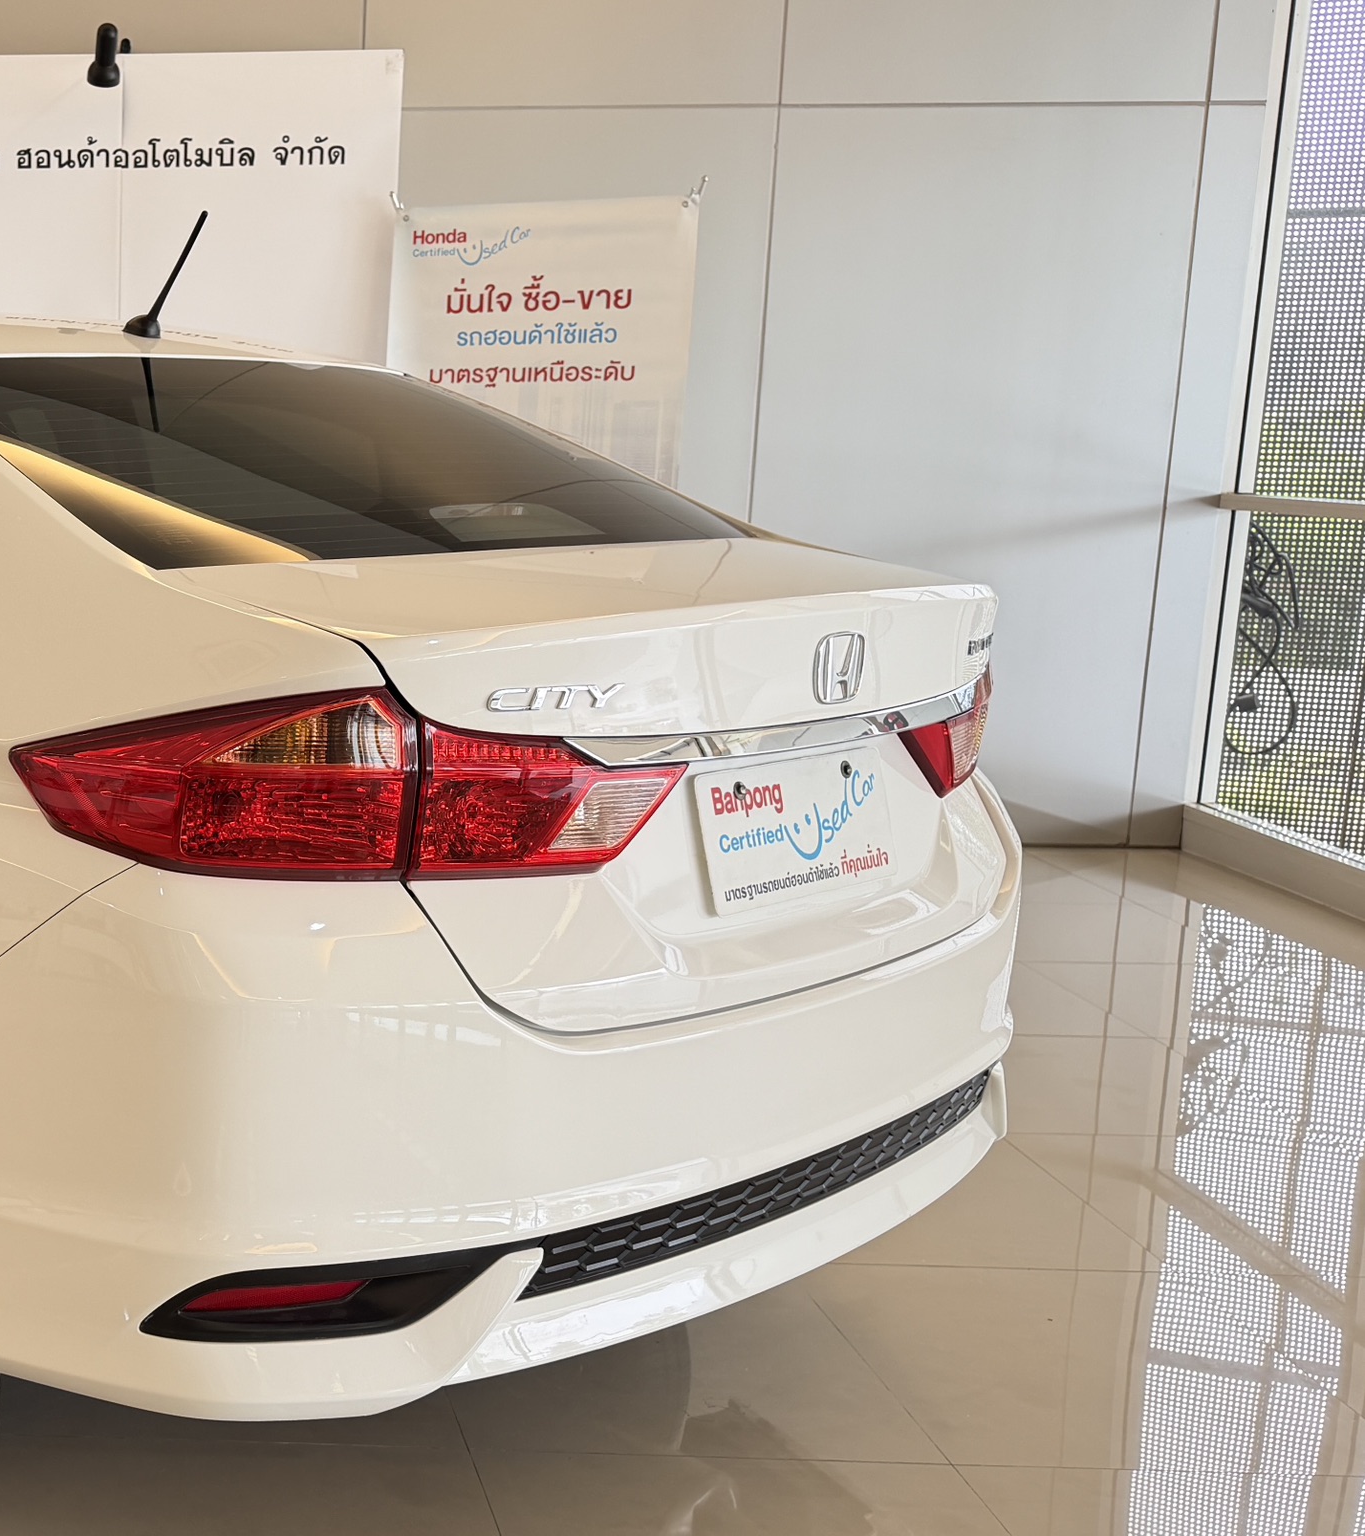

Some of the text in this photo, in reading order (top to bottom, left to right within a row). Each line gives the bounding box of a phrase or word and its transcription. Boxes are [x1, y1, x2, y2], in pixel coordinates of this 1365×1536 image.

[16, 137, 257, 169] ฮอนด้าออโตโมบิล
[271, 135, 347, 167] จำกัด
[412, 228, 468, 246] Honda
[412, 247, 456, 258] Certified
[510, 226, 532, 245] Car
[445, 275, 633, 315] มั่นใจ ซื้อ-ขาย
[456, 322, 618, 347] รถฮอนด้าใช้แล้ว
[428, 361, 635, 388] มาตรฐานเหนือระดับ
[486, 682, 626, 713] CITY
[718, 824, 784, 853] Certified
[851, 768, 875, 807] Car
